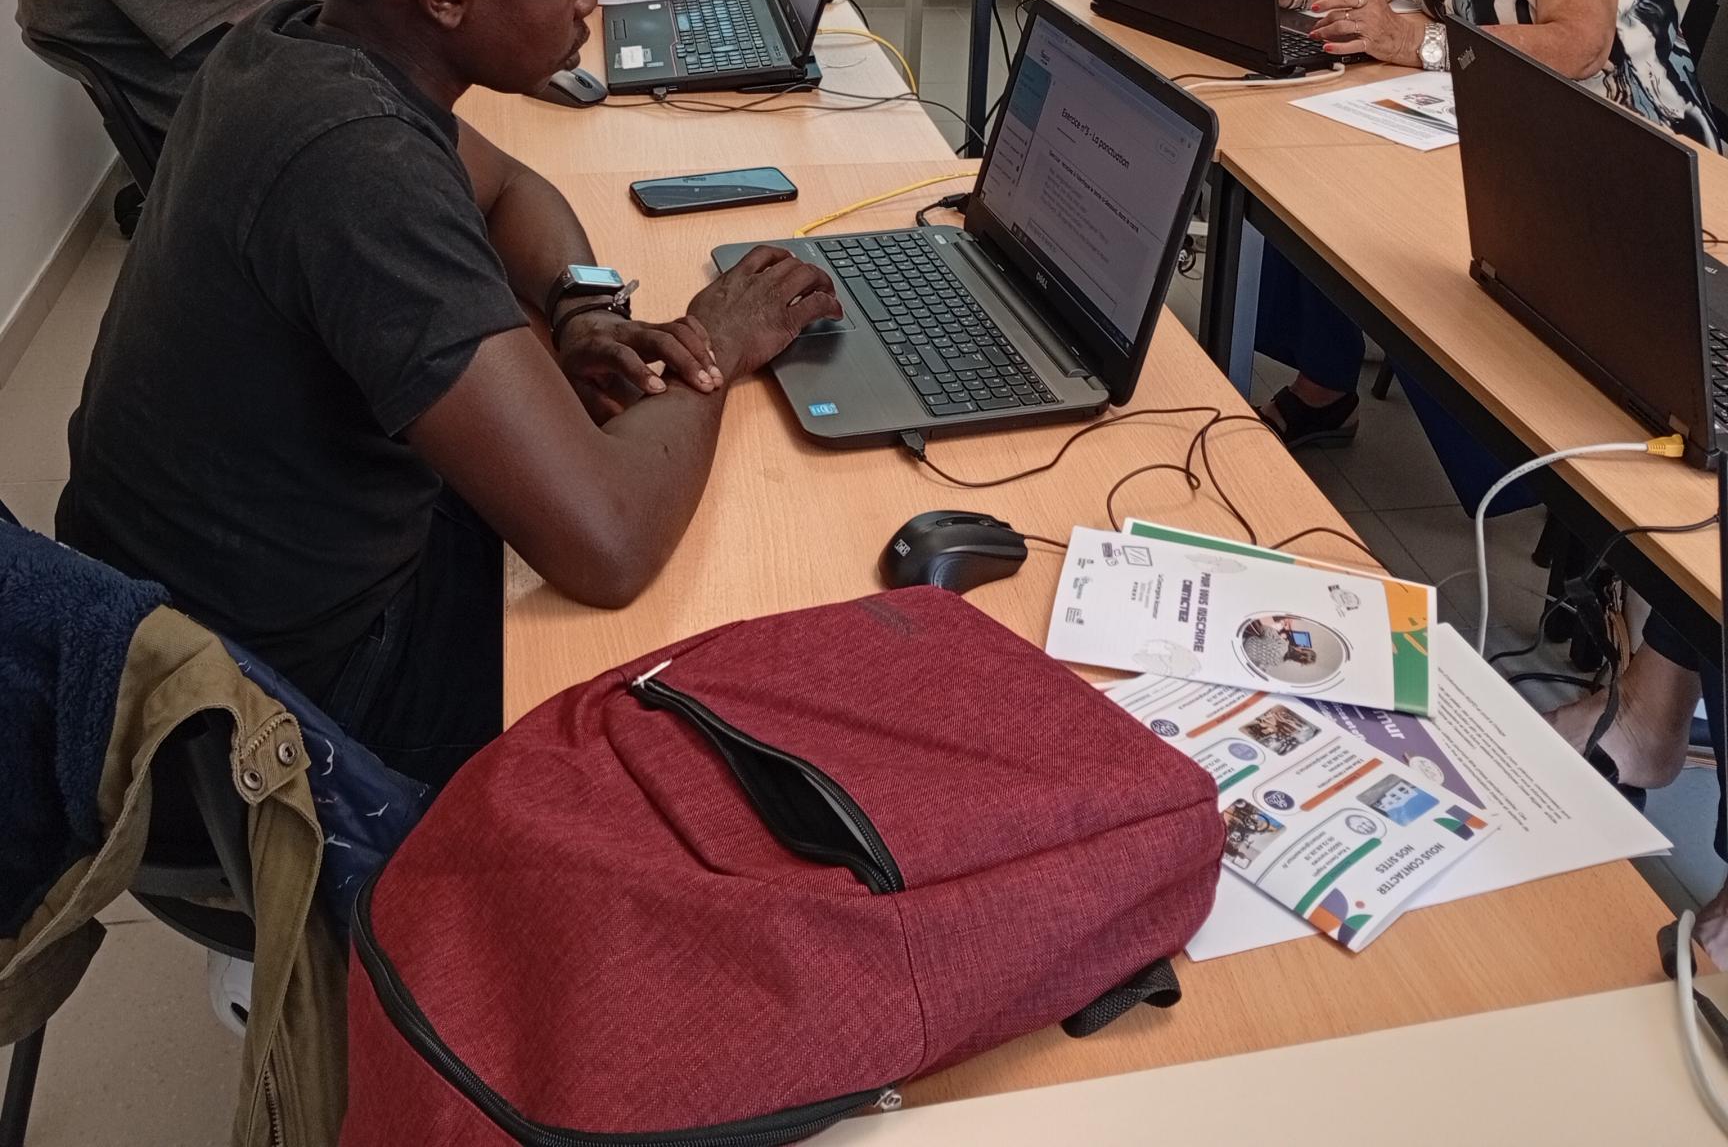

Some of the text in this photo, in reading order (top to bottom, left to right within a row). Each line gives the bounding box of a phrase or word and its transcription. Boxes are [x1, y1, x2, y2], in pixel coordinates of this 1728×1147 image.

[1062, 108, 1081, 129] Exercice
[1098, 139, 1130, 169] ponctuation
[1036, 271, 1047, 289] DELL
[1193, 606, 1208, 653] INSCRIRE
[1375, 843, 1416, 874] NOS SITES
[1376, 842, 1446, 895] NOUS CONTACTER
